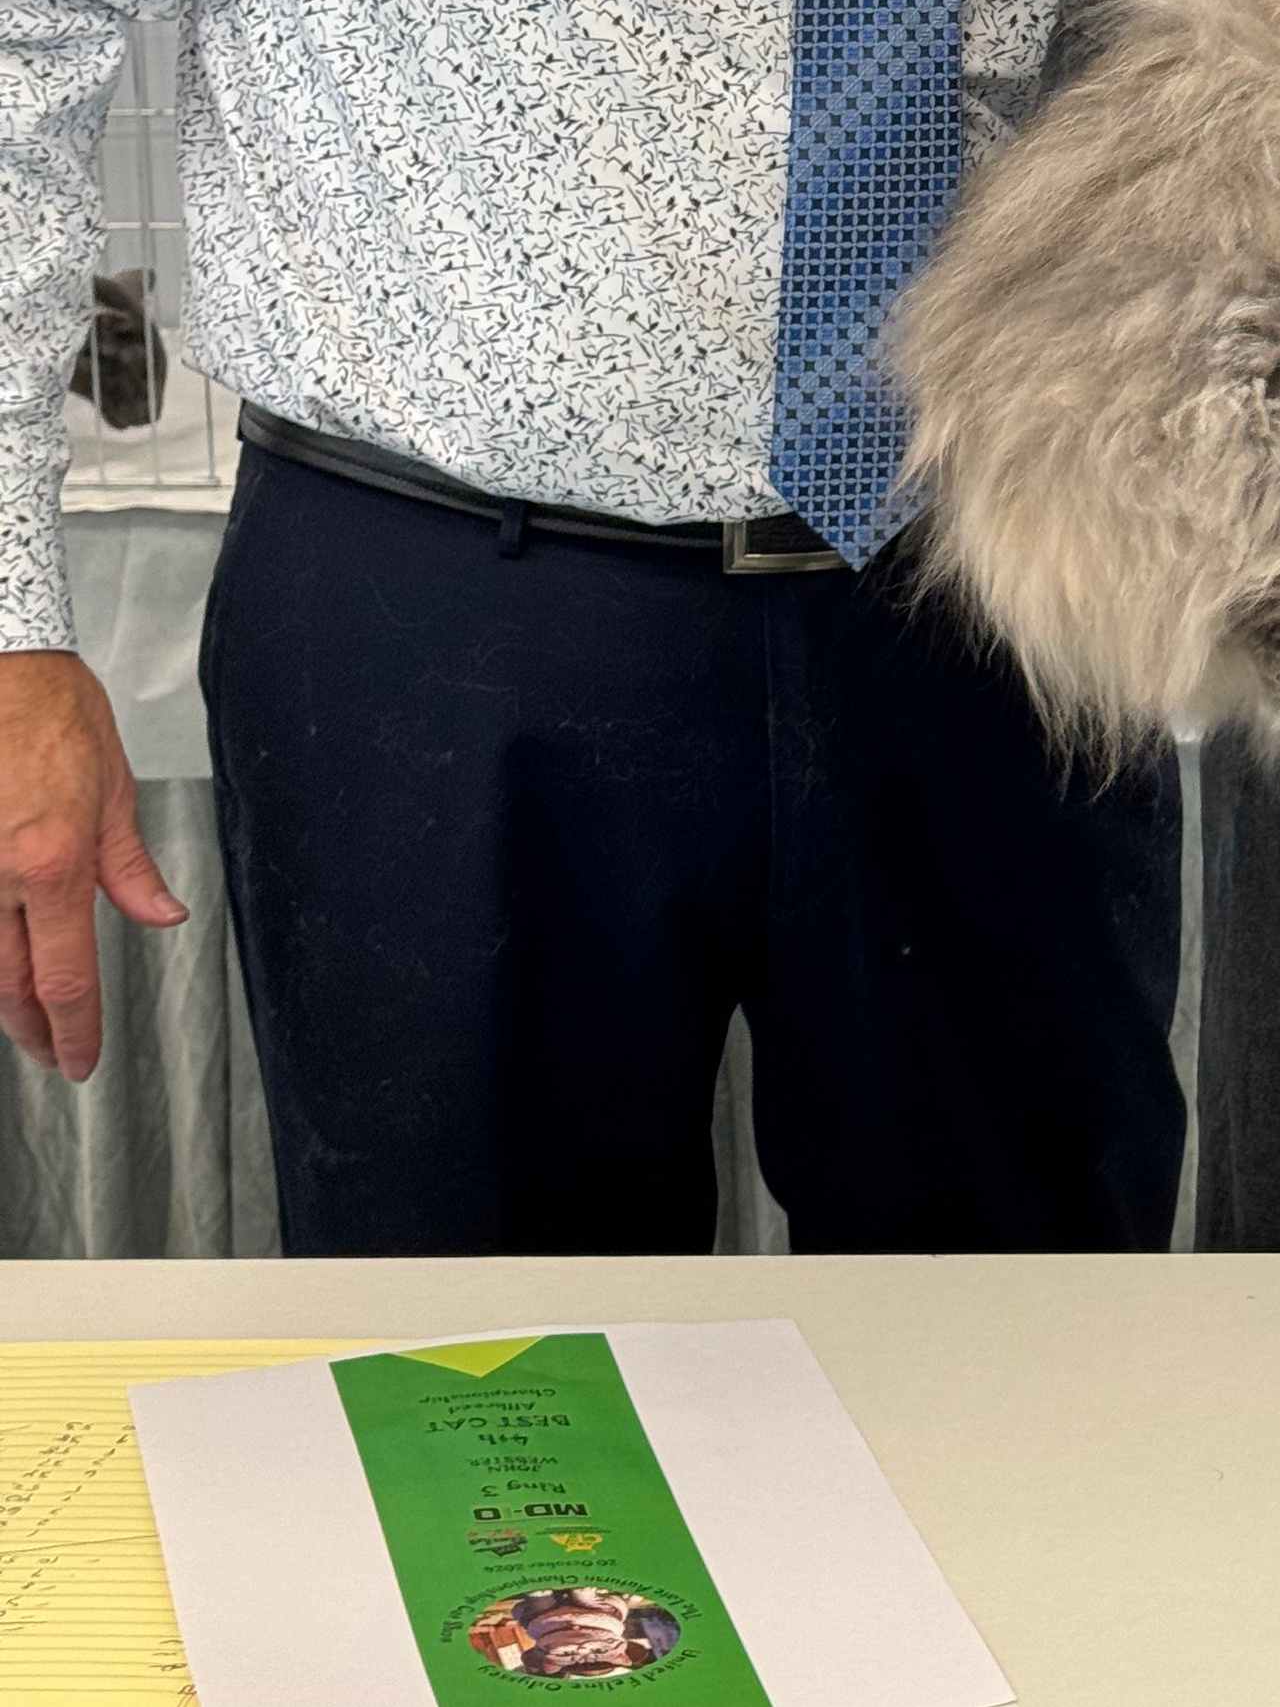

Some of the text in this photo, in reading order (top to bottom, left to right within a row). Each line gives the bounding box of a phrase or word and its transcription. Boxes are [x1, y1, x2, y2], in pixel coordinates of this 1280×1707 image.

[425, 1414, 571, 1433] BEST CAT
[506, 1479, 567, 1494] Ring
